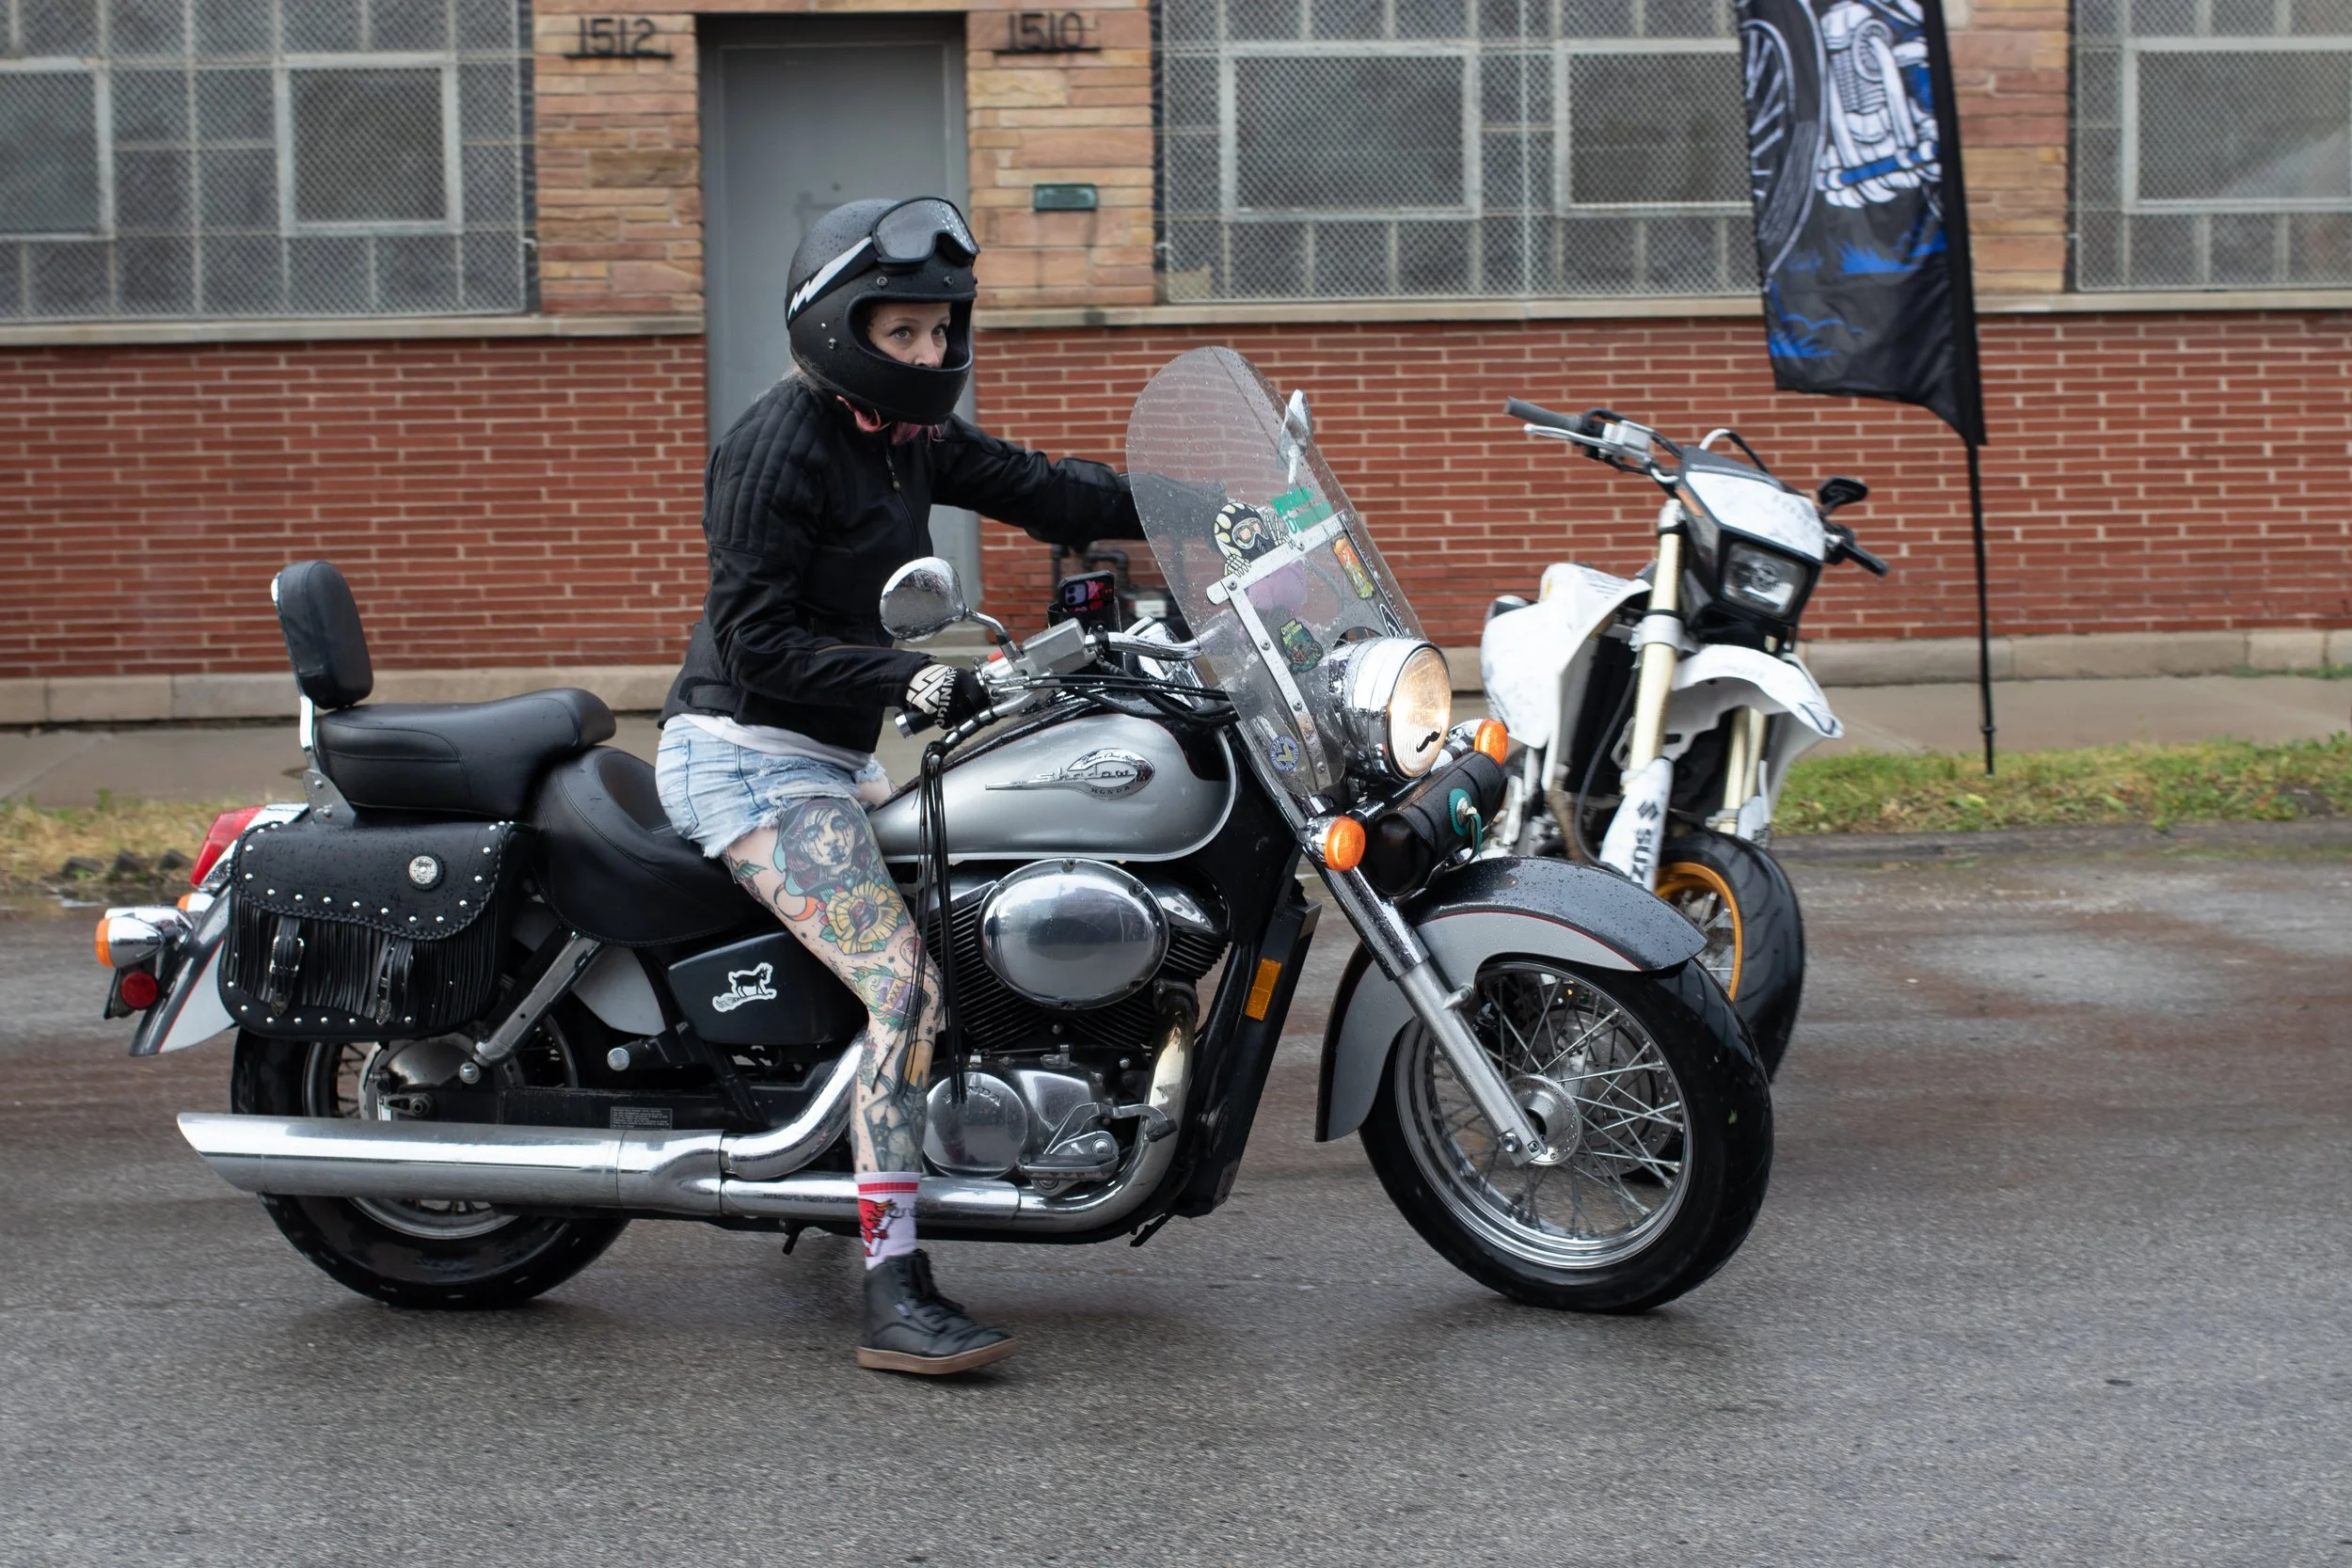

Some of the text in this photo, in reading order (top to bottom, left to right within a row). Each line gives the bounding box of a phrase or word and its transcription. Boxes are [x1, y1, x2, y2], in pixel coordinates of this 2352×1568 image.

[579, 16, 657, 55] 1512
[1008, 10, 1084, 51] 1510
[1091, 784, 1131, 796] HONDA
[942, 1085, 1001, 1107] HNDA
